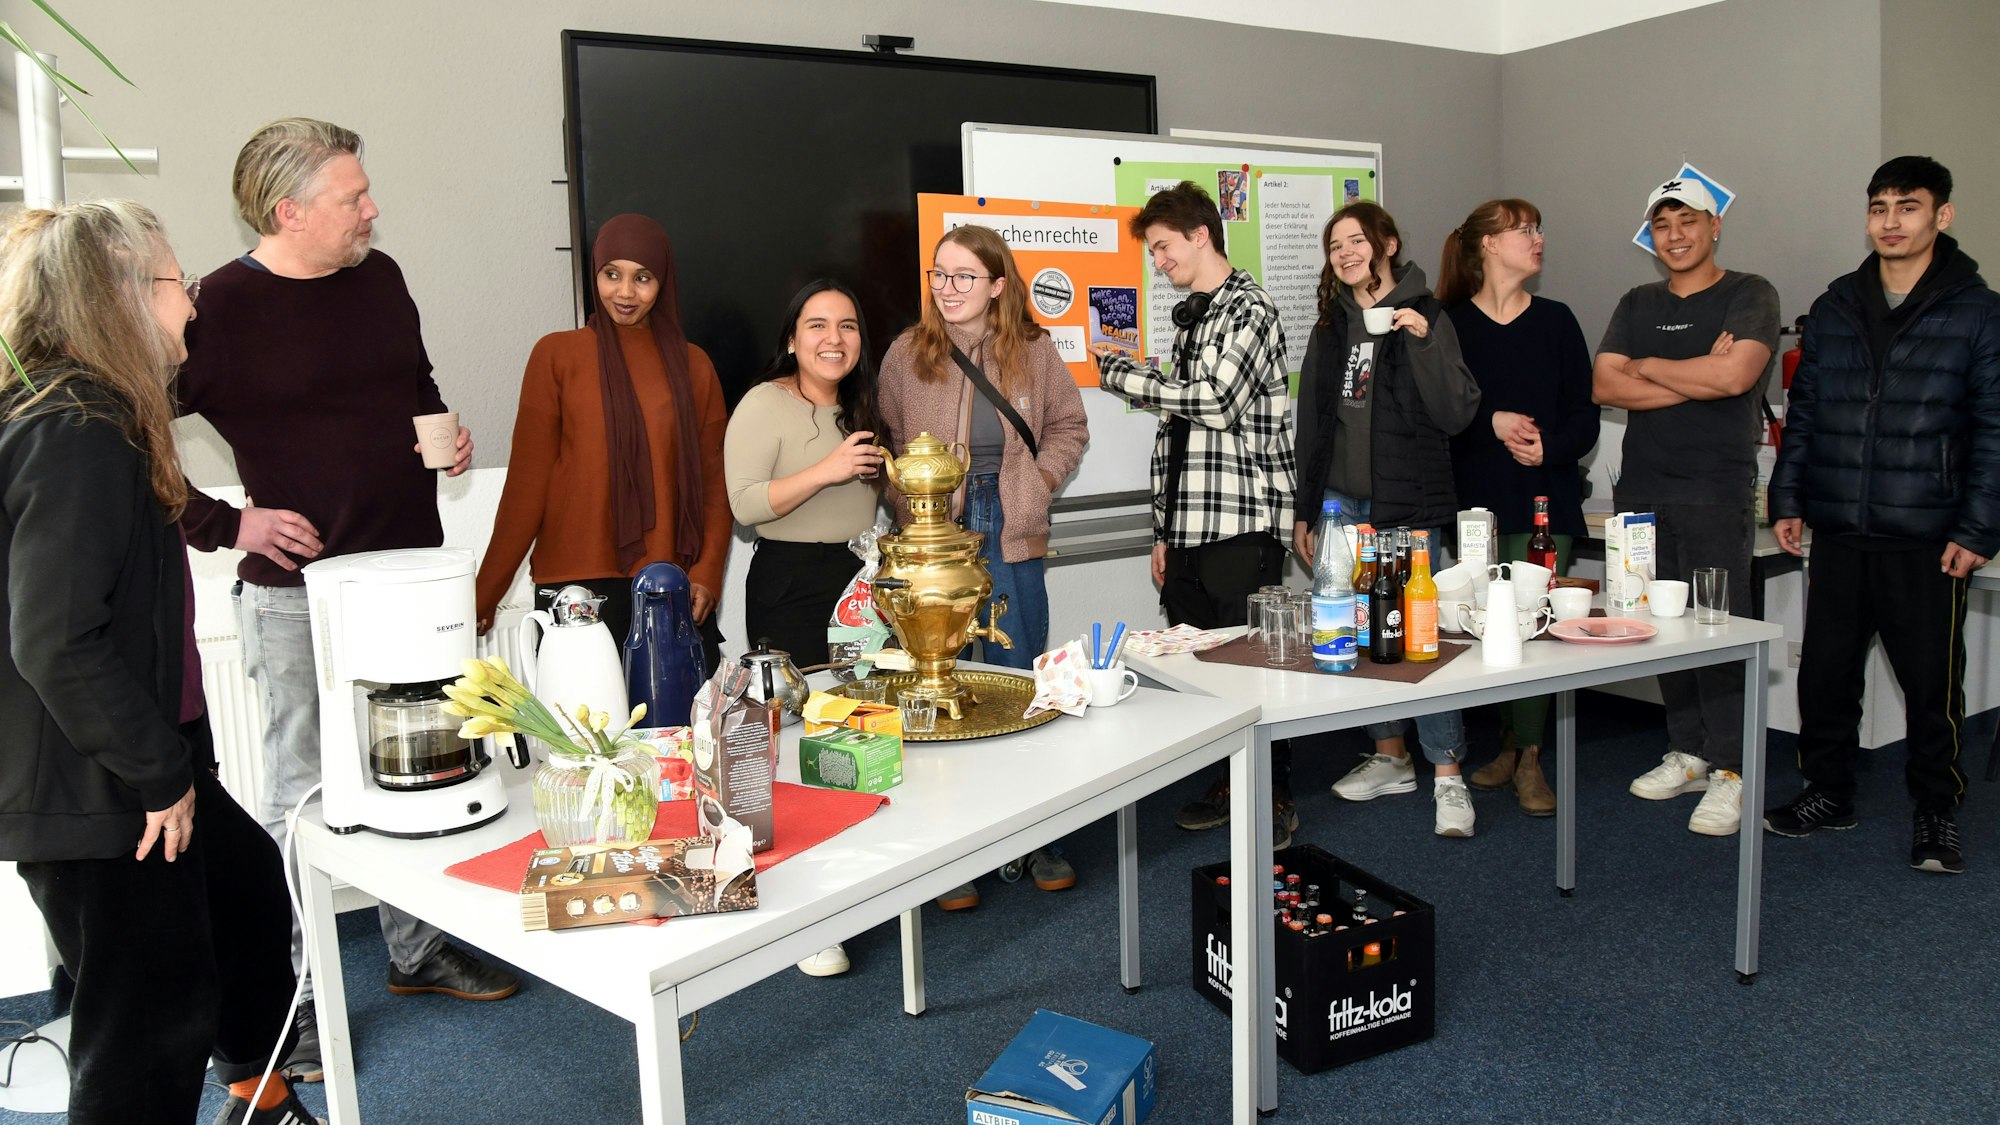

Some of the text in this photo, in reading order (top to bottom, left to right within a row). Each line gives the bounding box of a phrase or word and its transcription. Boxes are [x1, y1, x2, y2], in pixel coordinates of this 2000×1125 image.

[1265, 212, 1290, 220] Anspruch
[1284, 222, 1308, 230] Erklärung
[1266, 253, 1298, 261] irgendeinen
[1267, 274, 1292, 282] aufgrund
[1152, 292, 1190, 301] jede Diskrim
[1292, 304, 1314, 312] Religion,
[1101, 323, 1137, 341] REALITY
[1342, 344, 1360, 397] うちはイタチ
[436, 622, 465, 631] SEVERIN
[1327, 983, 1412, 1033] fritz-kola
[1329, 1010, 1412, 1041] KOFFEINHALTIGE LIMONADE
